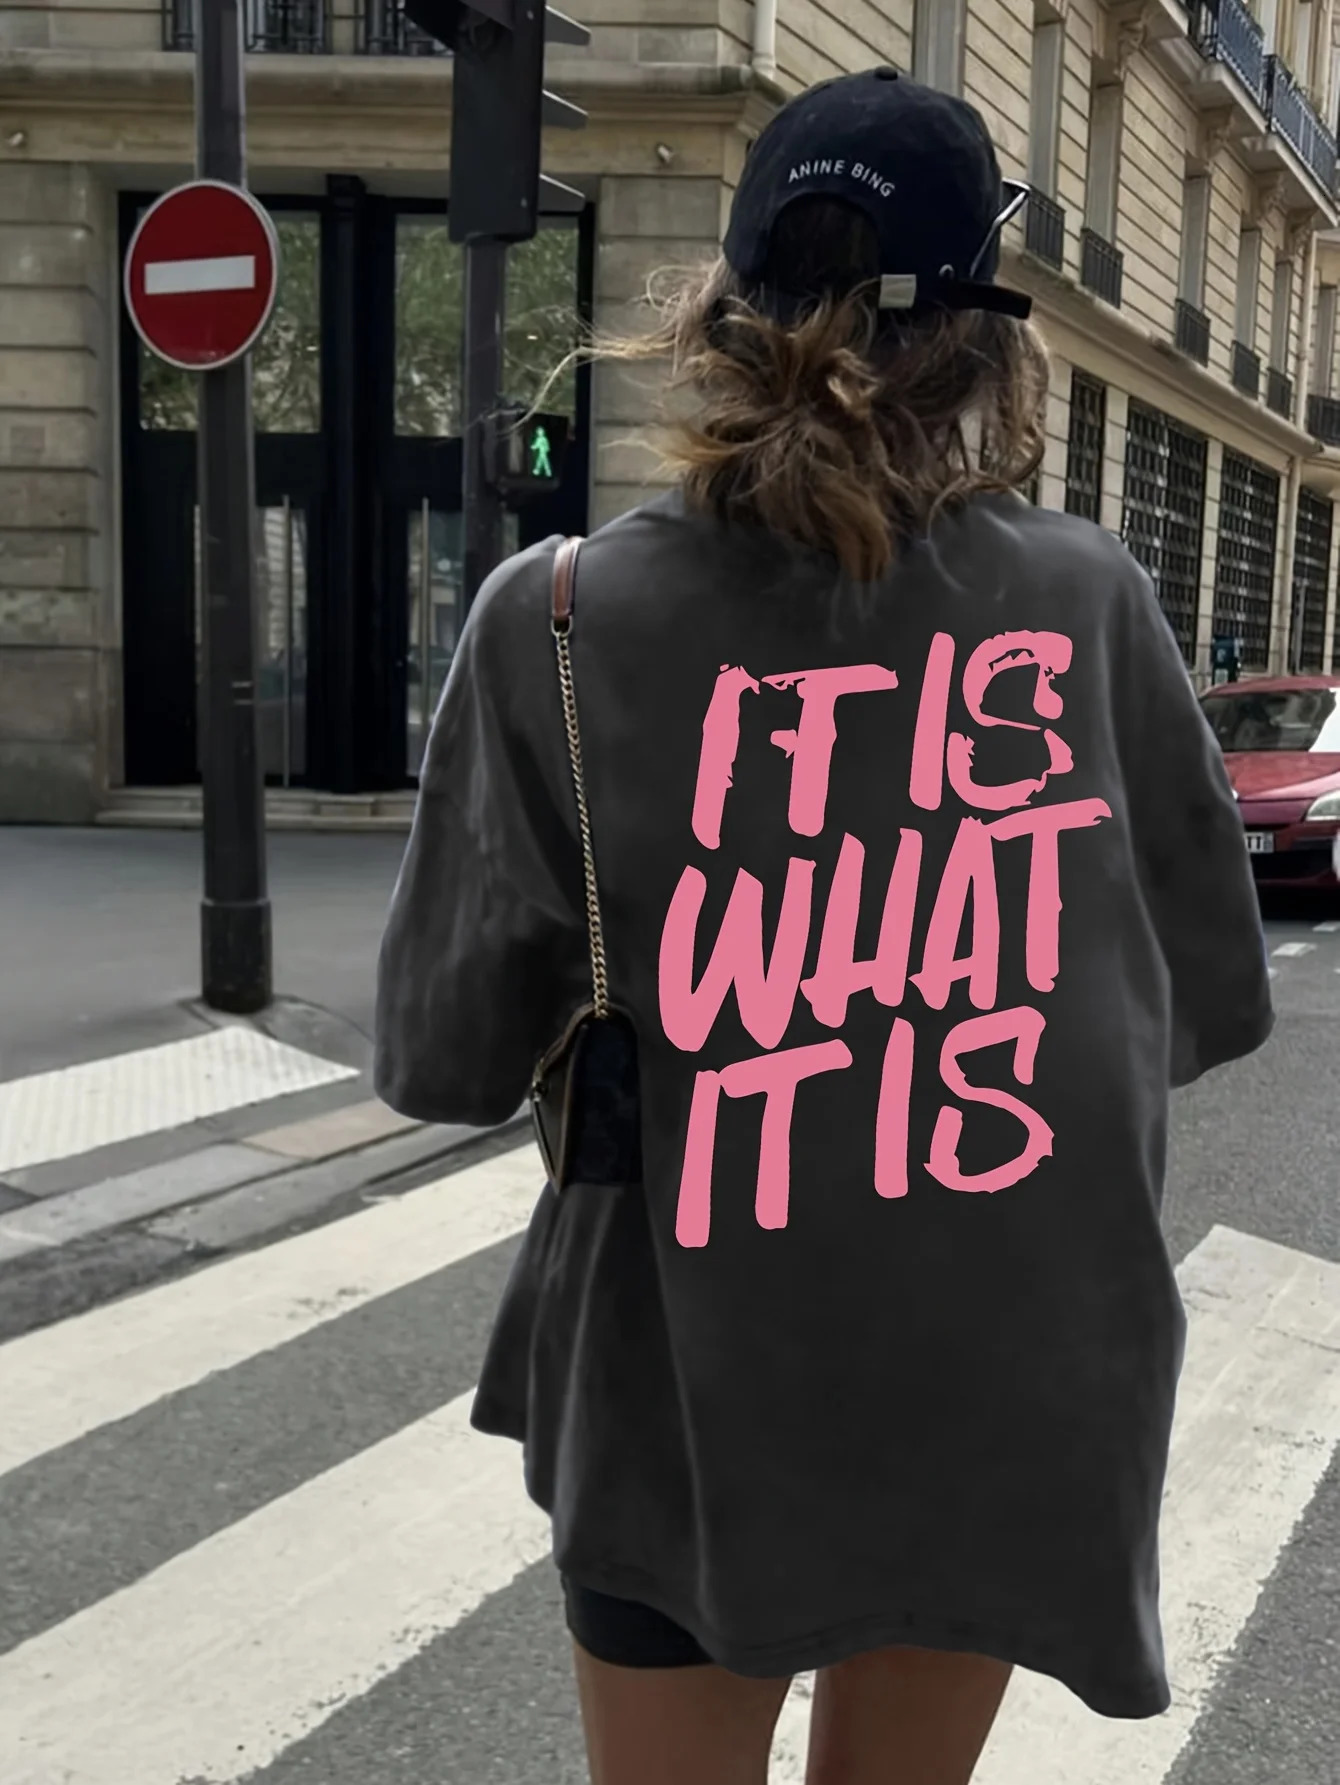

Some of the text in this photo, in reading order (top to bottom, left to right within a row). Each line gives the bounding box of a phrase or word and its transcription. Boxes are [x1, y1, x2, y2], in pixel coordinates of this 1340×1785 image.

[788, 159, 895, 197] ANINE BING
[692, 630, 1074, 849] IT IS
[659, 798, 1111, 1051] WHAT
[675, 1005, 1054, 1248] IT IS
